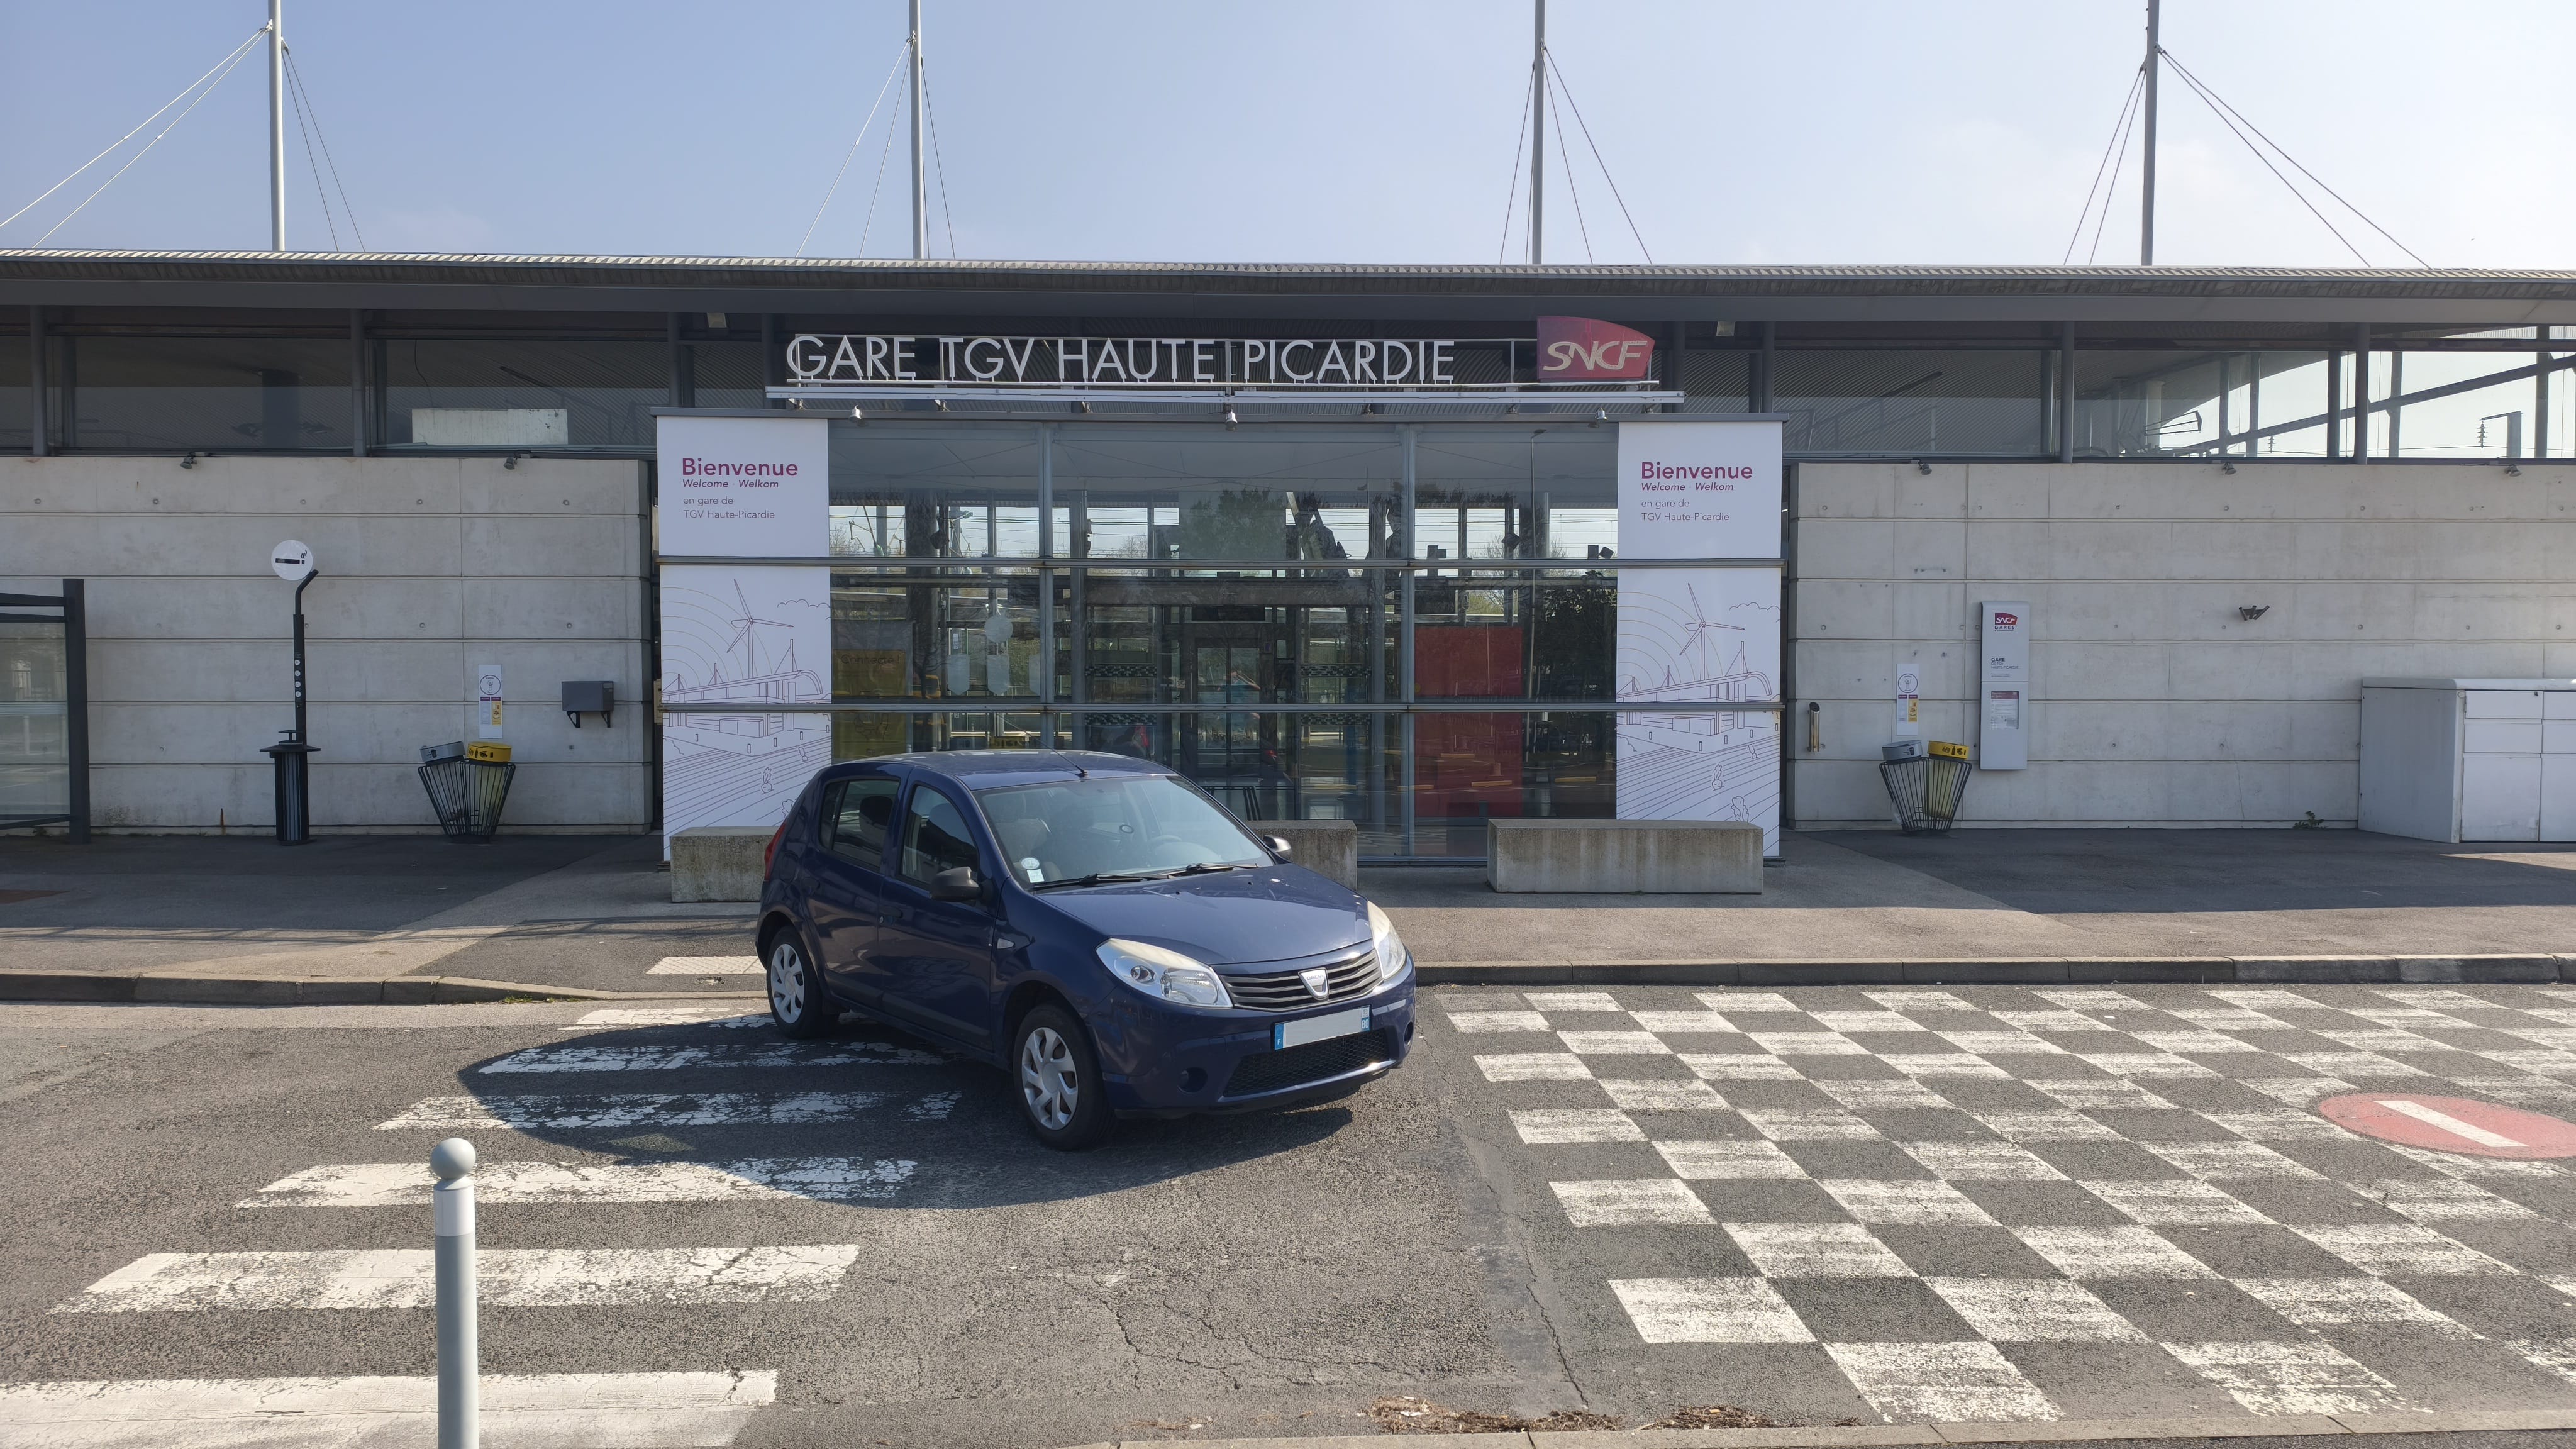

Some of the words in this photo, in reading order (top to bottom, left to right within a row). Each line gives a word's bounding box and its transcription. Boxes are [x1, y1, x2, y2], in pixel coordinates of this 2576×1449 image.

[786, 335, 916, 377] GARE
[938, 337, 1035, 378] TGV
[1058, 338, 1214, 379] HAUTE
[1244, 340, 1454, 380] PICARDIE
[1543, 340, 1648, 371] SNCF
[682, 457, 798, 476] Bienvenue
[1641, 462, 1753, 479] Bienvenue
[682, 479, 728, 488] Welcome
[738, 479, 779, 488] Welkom
[1641, 482, 1685, 491] Welcome
[1695, 482, 1734, 491] Welkom
[697, 497, 718, 506] gare
[721, 496, 733, 504] de
[1655, 500, 1675, 509] gare
[1678, 499, 1690, 507] de
[684, 509, 704, 518] TGV
[707, 509, 775, 519] Haute-Picardie
[1641, 513, 1661, 521] TGV
[1664, 513, 1729, 521] Haute-Picardie
[1362, 1019, 1369, 1029] 80
